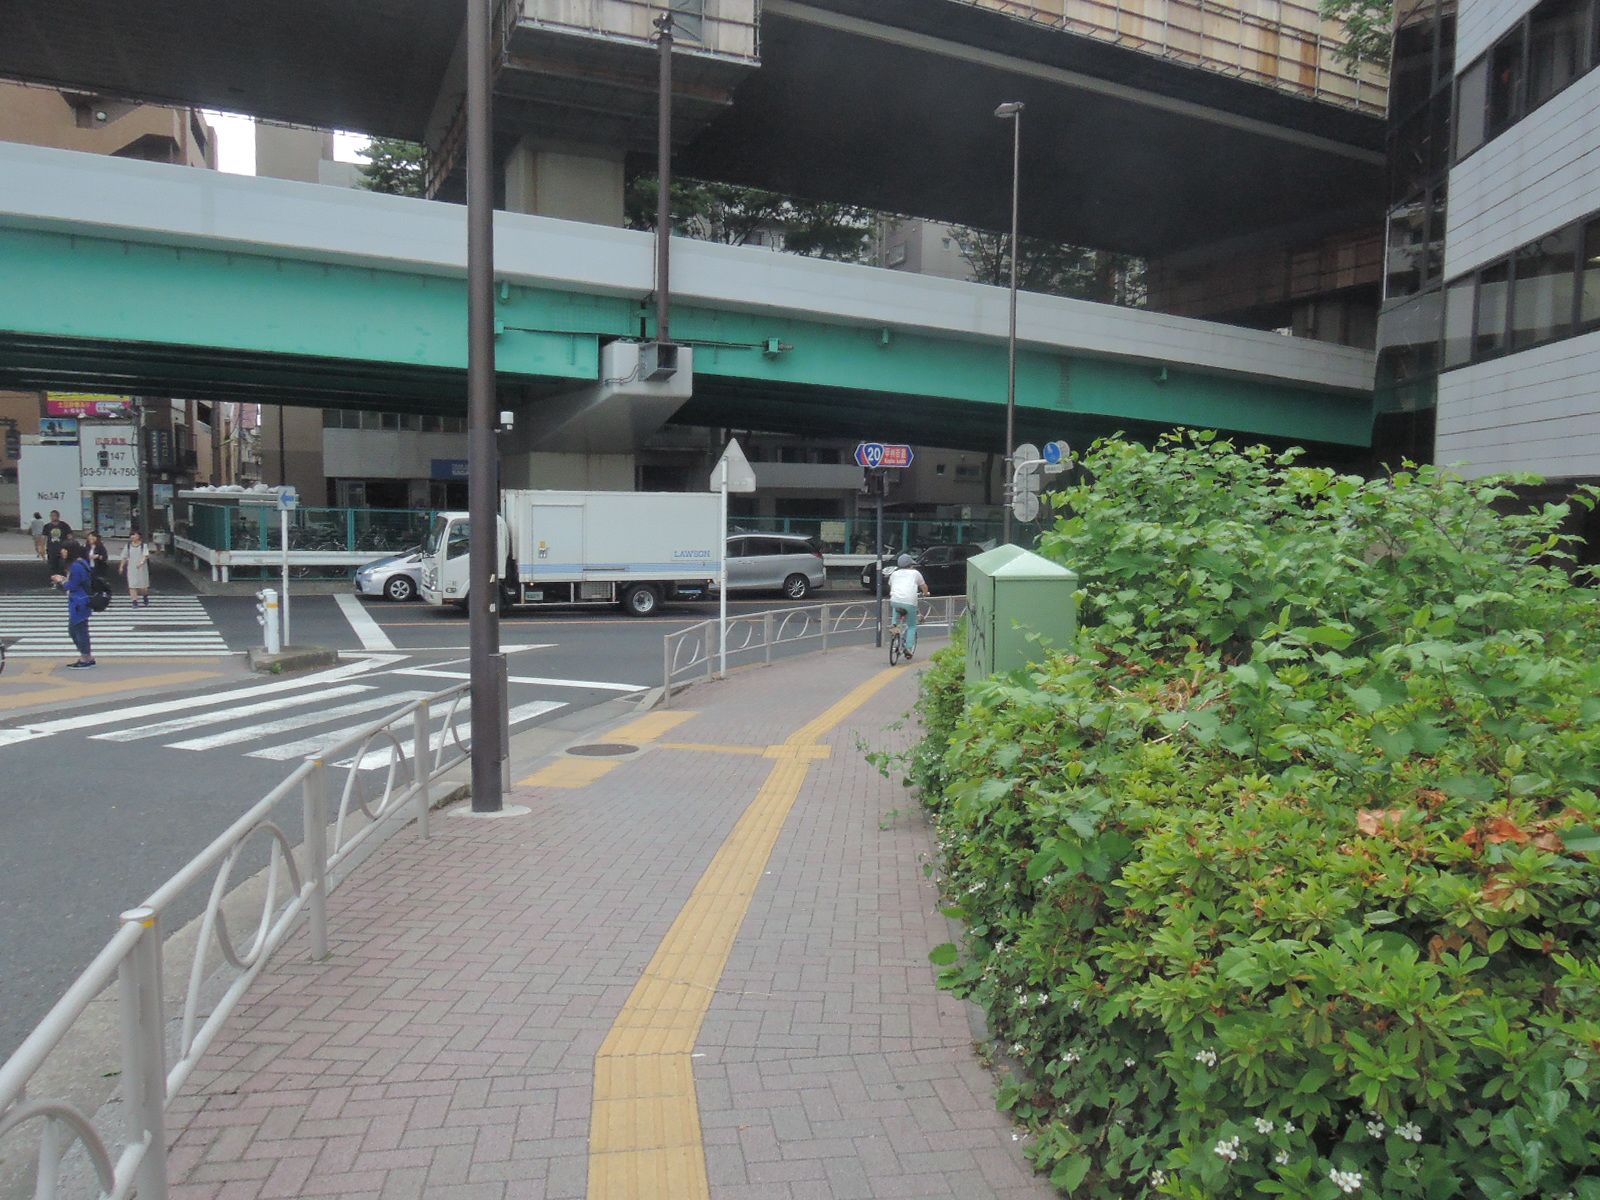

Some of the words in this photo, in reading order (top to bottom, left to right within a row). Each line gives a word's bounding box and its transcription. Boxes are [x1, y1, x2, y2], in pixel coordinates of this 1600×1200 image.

[867, 447, 881, 461] 20
[83, 467, 138, 477] 03-5774-750
[38, 491, 65, 501] No.147
[673, 550, 711, 558] LAWSON
